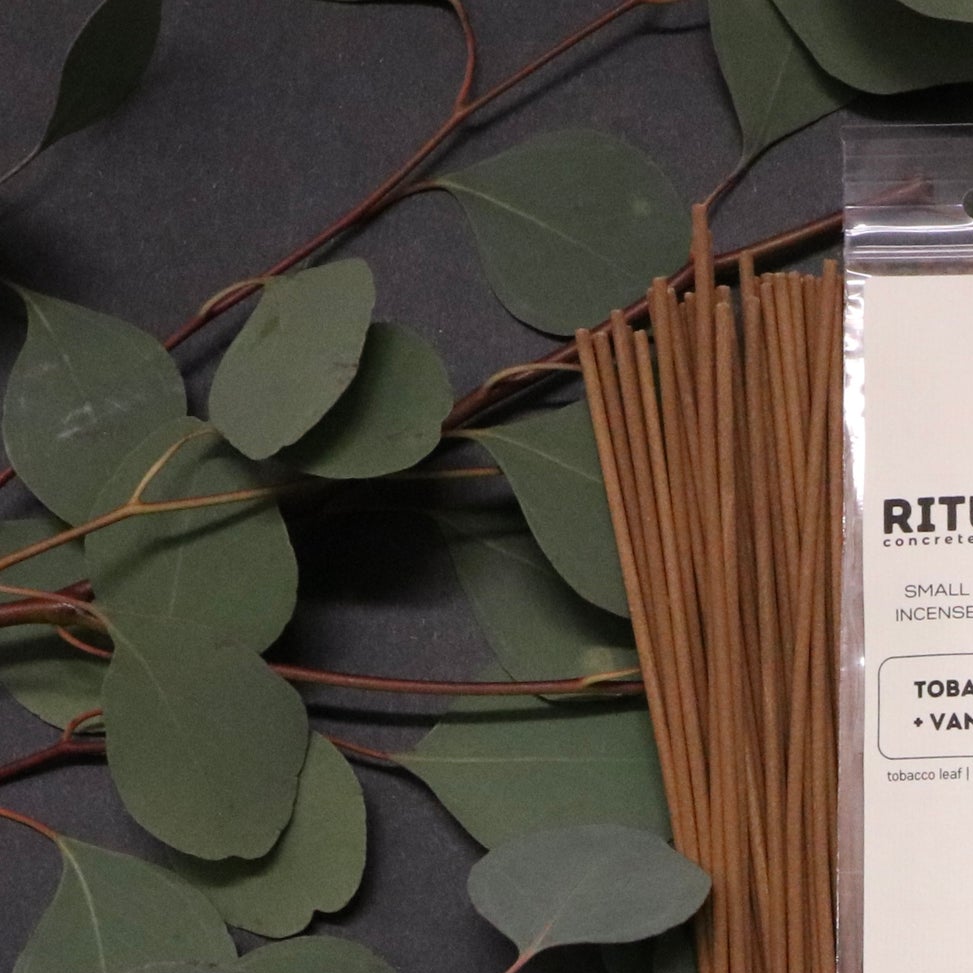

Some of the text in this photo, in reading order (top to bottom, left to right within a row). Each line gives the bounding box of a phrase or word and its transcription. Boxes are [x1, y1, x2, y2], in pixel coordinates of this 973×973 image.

[904, 583, 970, 599] SMALL
[887, 769, 936, 782] tobacco
[939, 767, 962, 780] leaf
